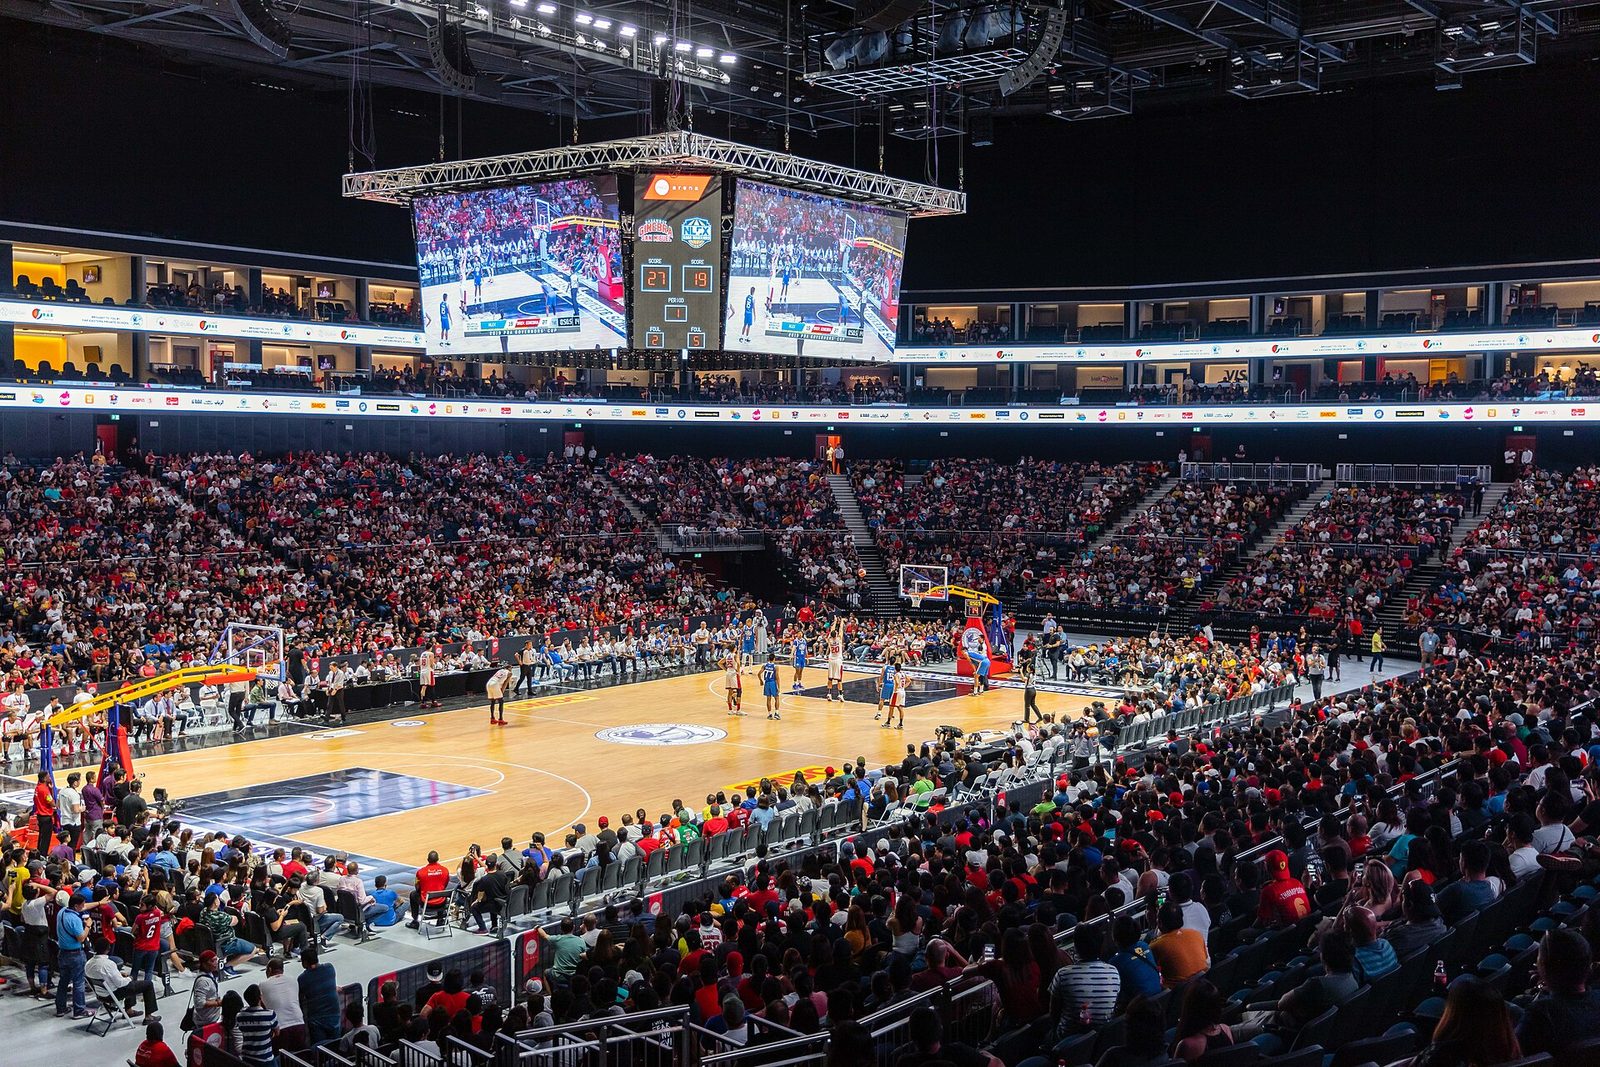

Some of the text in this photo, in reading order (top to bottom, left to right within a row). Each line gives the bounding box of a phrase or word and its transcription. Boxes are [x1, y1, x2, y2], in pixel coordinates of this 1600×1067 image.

[639, 222, 673, 236] GINEBRA
[683, 226, 709, 236] NLEX
[647, 271, 666, 286] 27
[694, 272, 707, 287] 19
[651, 335, 659, 346] 2
[693, 335, 700, 346] 5
[1223, 369, 1248, 381] VIS
[830, 645, 840, 653] 20
[764, 669, 774, 677] 77
[740, 819, 746, 829] 5
[1280, 887, 1305, 899] THOMPSON
[1293, 897, 1307, 919] 6
[147, 925, 156, 939] 6
[219, 962, 224, 970] D
[165, 974, 170, 984] E
